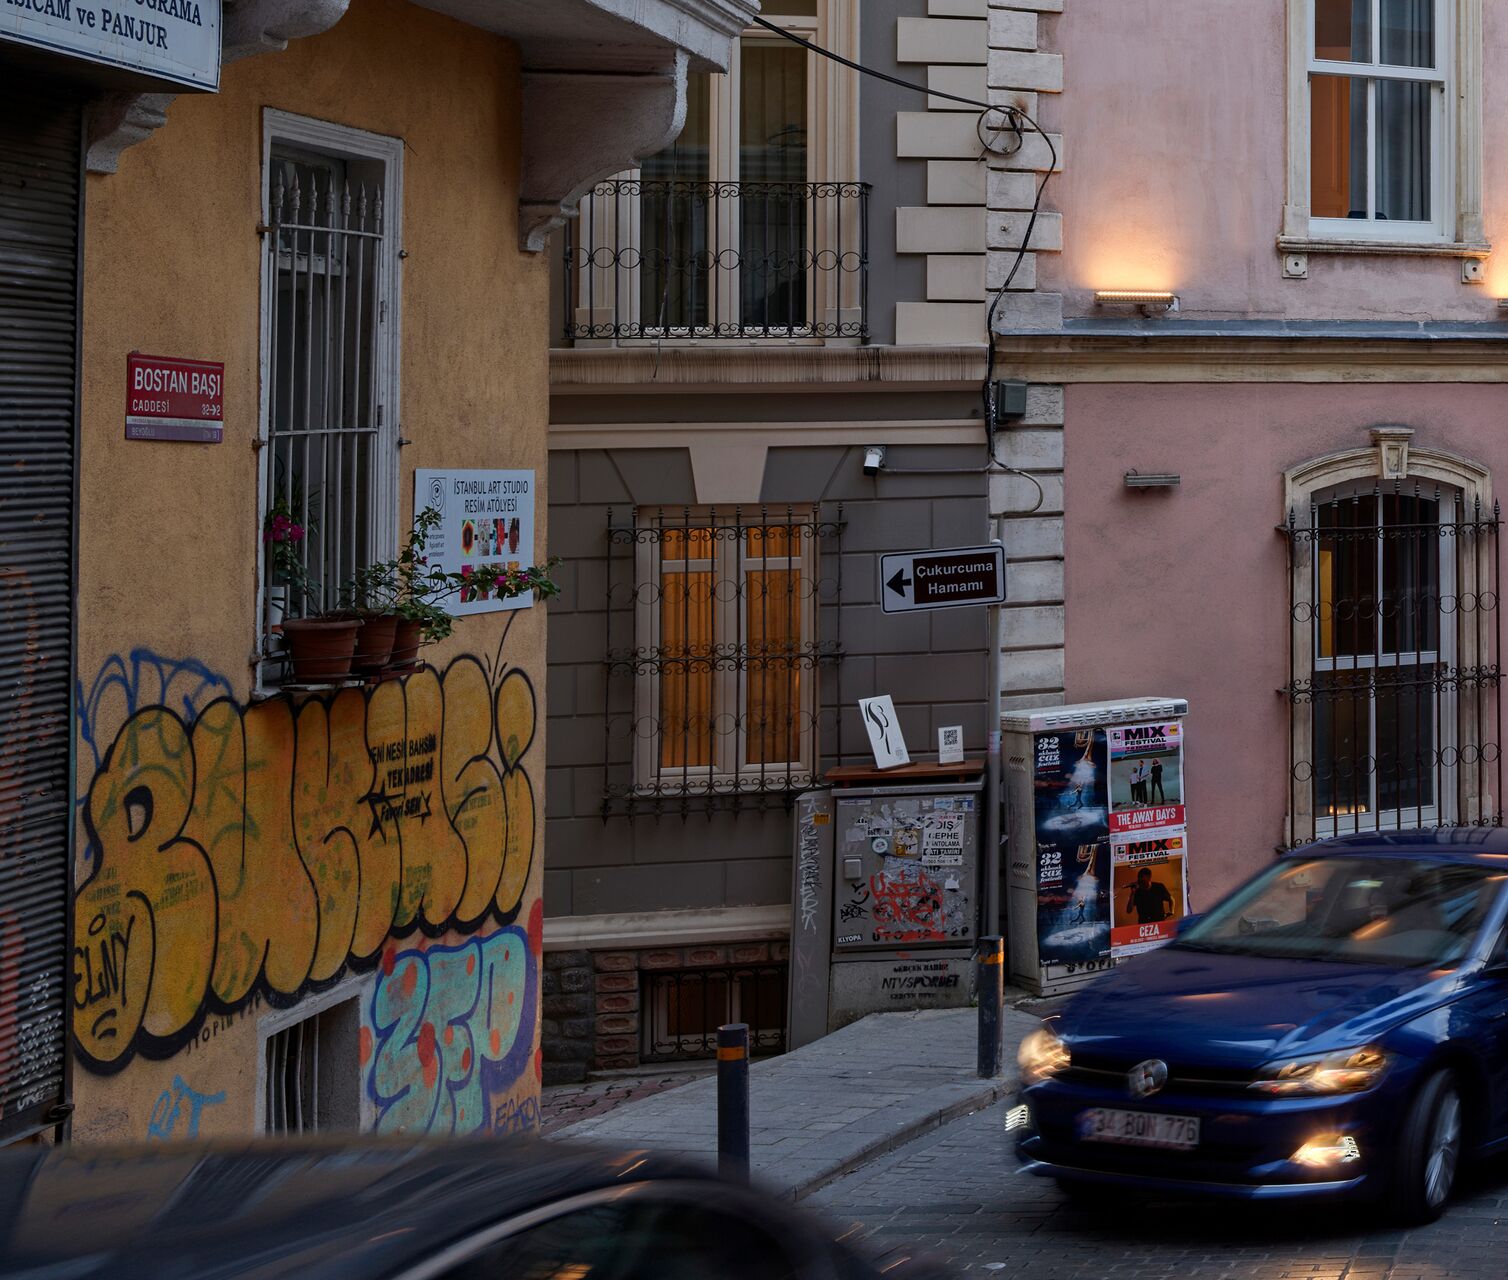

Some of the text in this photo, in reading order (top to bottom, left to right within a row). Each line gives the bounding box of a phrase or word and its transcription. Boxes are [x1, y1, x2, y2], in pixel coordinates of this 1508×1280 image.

[76, 7, 95, 28] ve
[102, 8, 168, 50] PANJUR
[134, 367, 188, 394] BOSTAN
[132, 399, 170, 413] CADDESİ
[453, 478, 529, 495] İSTANBUL ART STUDIO
[464, 496, 518, 513] RESİM ATÖLYESİ
[916, 562, 983, 578] Çukurcuma
[928, 581, 983, 595] Hamamı
[1124, 725, 1166, 740] MIX
[1038, 736, 1060, 750] 32
[1125, 737, 1167, 746] FESTIVAL
[1117, 813, 1131, 826] THE
[1132, 809, 1155, 824] AWAY
[1156, 807, 1176, 821] DAYS
[1129, 838, 1169, 854] MIX
[1040, 851, 1062, 866] 32
[1128, 851, 1169, 860] FESTIVAL
[1139, 924, 1160, 937] CEZA
[1165, 1117, 1197, 1141] 776
